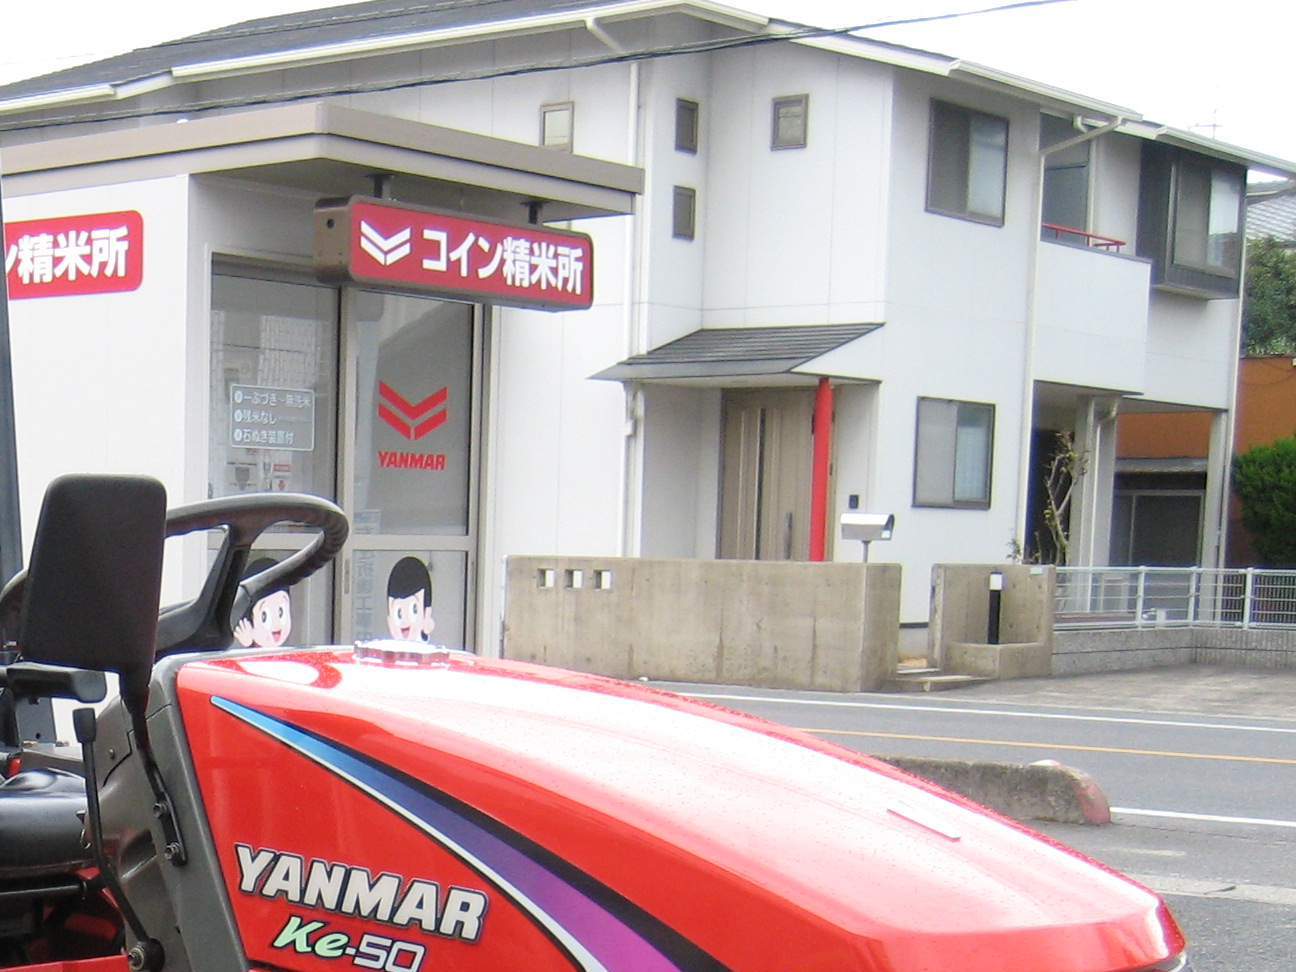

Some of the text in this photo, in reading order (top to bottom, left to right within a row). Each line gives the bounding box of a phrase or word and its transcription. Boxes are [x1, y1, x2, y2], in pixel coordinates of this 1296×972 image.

[422, 227, 584, 295] コイン精米所
[377, 450, 447, 471] YANMAR
[234, 843, 489, 944] YANMAR
